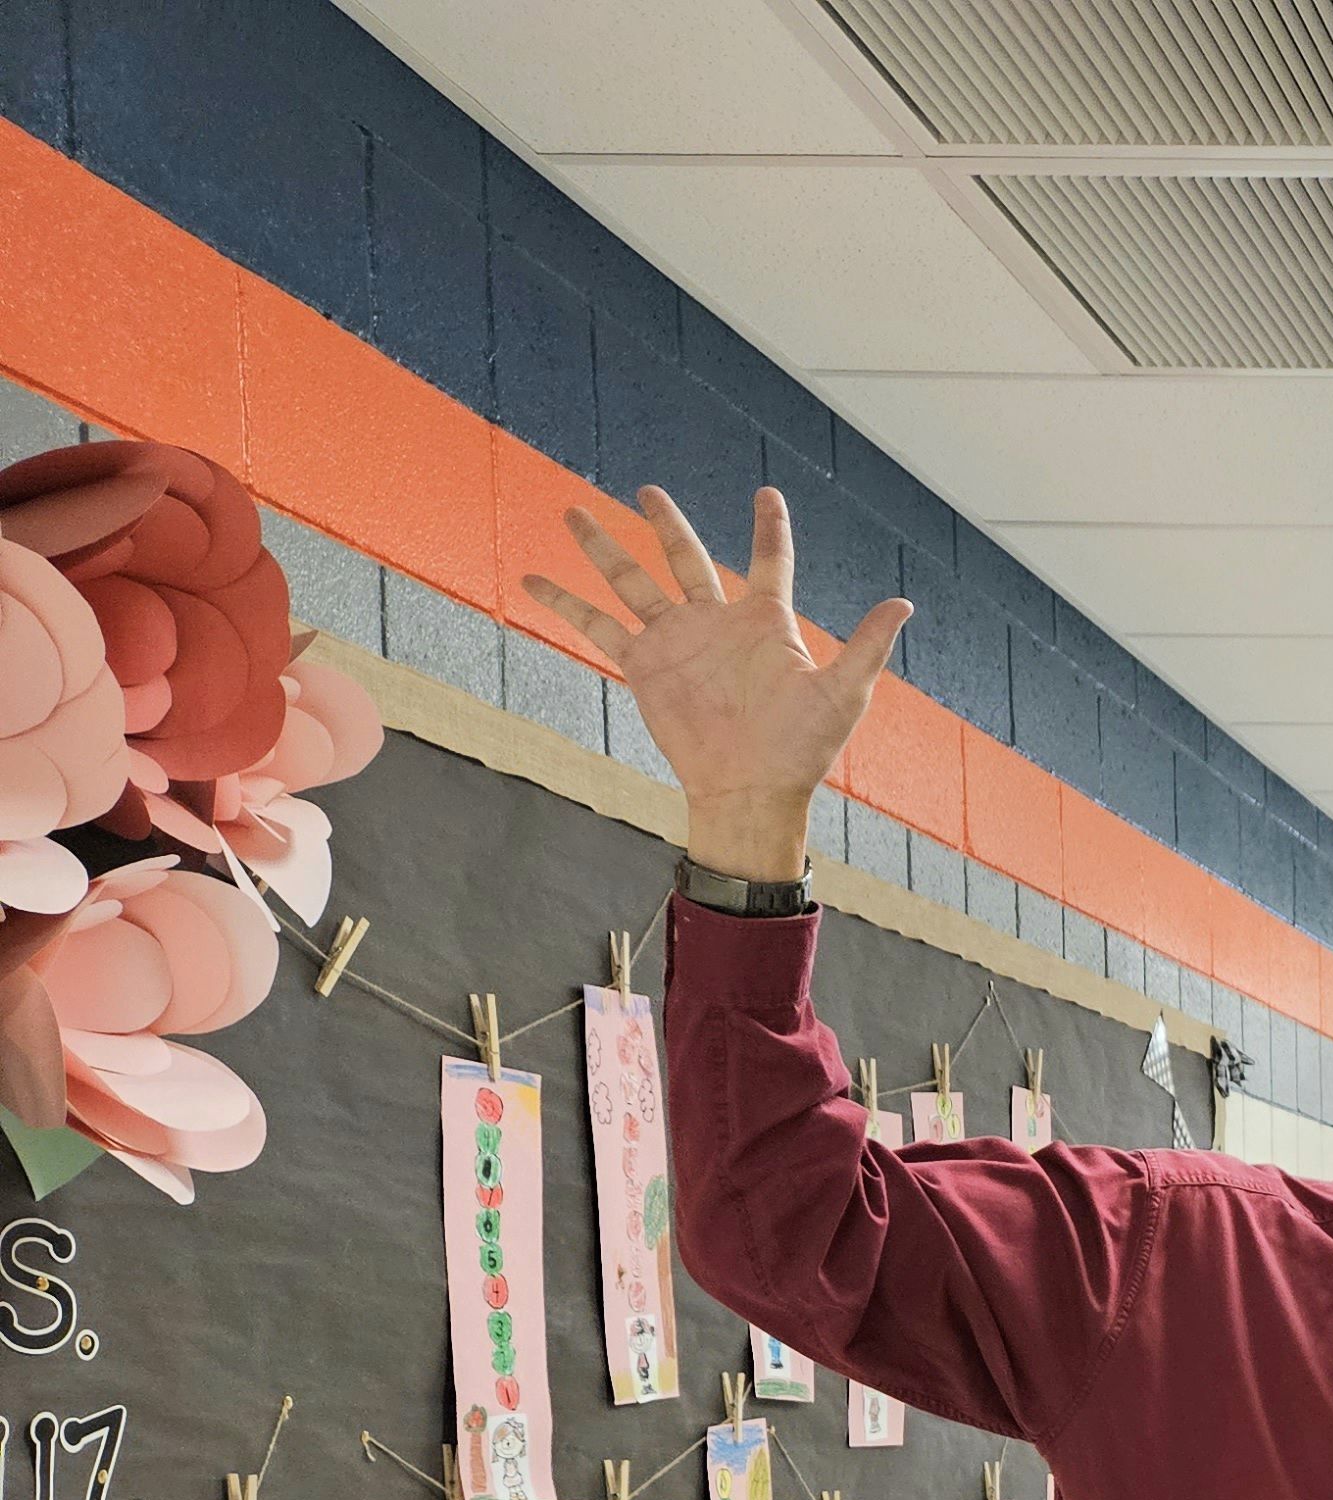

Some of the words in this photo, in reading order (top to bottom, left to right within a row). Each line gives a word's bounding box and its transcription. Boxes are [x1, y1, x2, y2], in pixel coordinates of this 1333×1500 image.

[487, 1250, 497, 1269] 5
[491, 1282, 500, 1304] 4
[495, 1320, 504, 1338] 3
